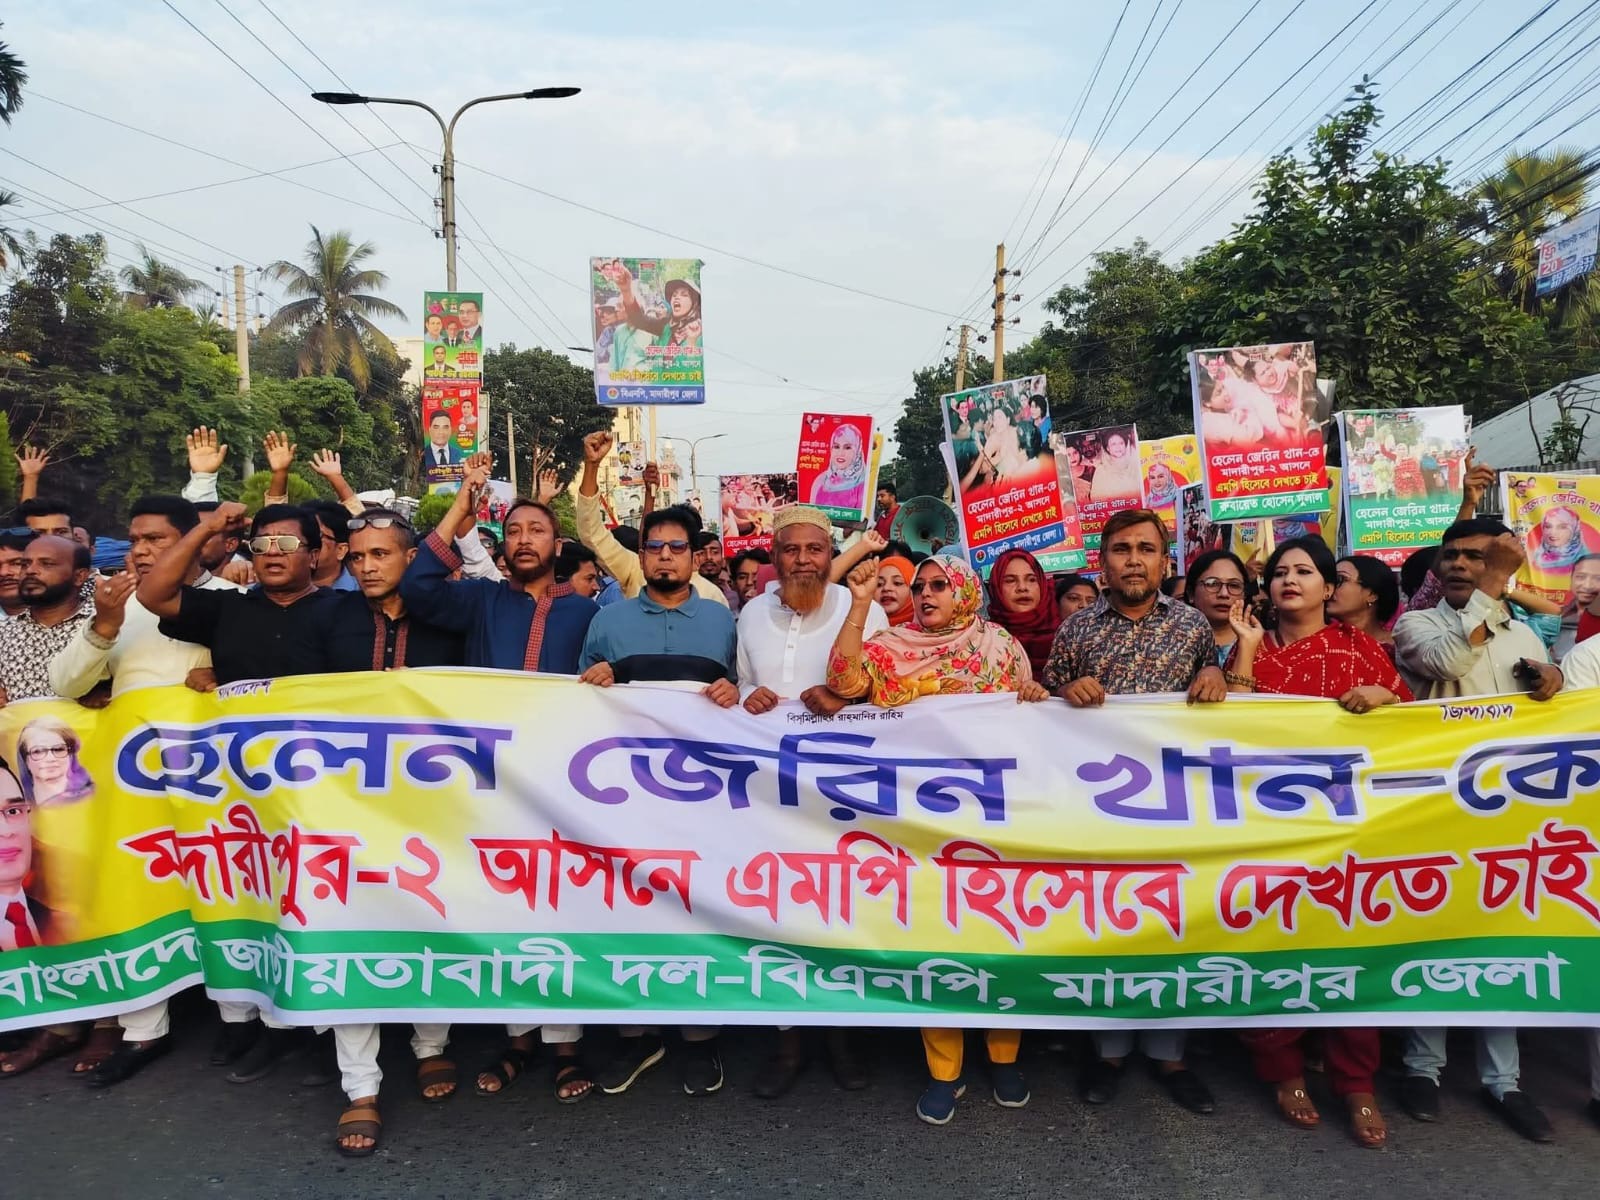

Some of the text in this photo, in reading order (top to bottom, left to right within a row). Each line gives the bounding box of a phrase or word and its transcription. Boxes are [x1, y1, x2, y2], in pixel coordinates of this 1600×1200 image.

[1211, 447, 1320, 466] হেলেন জেরিন খান-কে
[1221, 461, 1311, 477] মাদারীপুর-২ আসনে
[1216, 472, 1319, 493] এমপি হিসেবে দেখতে চাই
[967, 497, 996, 514] হেলেন
[998, 487, 1026, 505] জেরিন
[1025, 495, 1051, 510] আসনে
[1551, 489, 1586, 505] জেরিন
[1355, 507, 1389, 519] হেলেন
[1392, 503, 1426, 517] জেরিন
[973, 525, 993, 541] এমপি
[994, 518, 1019, 535] হিসেবে
[1021, 511, 1044, 527] দেখতে
[1045, 505, 1057, 520] চাই
[1363, 517, 1423, 529] মাদারীপুর-২
[1360, 531, 1382, 544] এমপি
[1386, 530, 1415, 543] হিসেবে
[116, 718, 1600, 823] হেলেন জেরিন খান-কে
[470, 828, 702, 914] আসনে
[725, 830, 916, 926] এমপি
[933, 839, 1191, 945] হিসেবে
[1219, 853, 1459, 931] দেখতে
[1473, 821, 1600, 923] চাই
[0, 926, 202, 1007] বাংলাদে
[602, 944, 1016, 1011] দল-বিএনপি,
[1040, 956, 1366, 1012] মাদারীপুর
[1390, 950, 1572, 1000] জেলা
